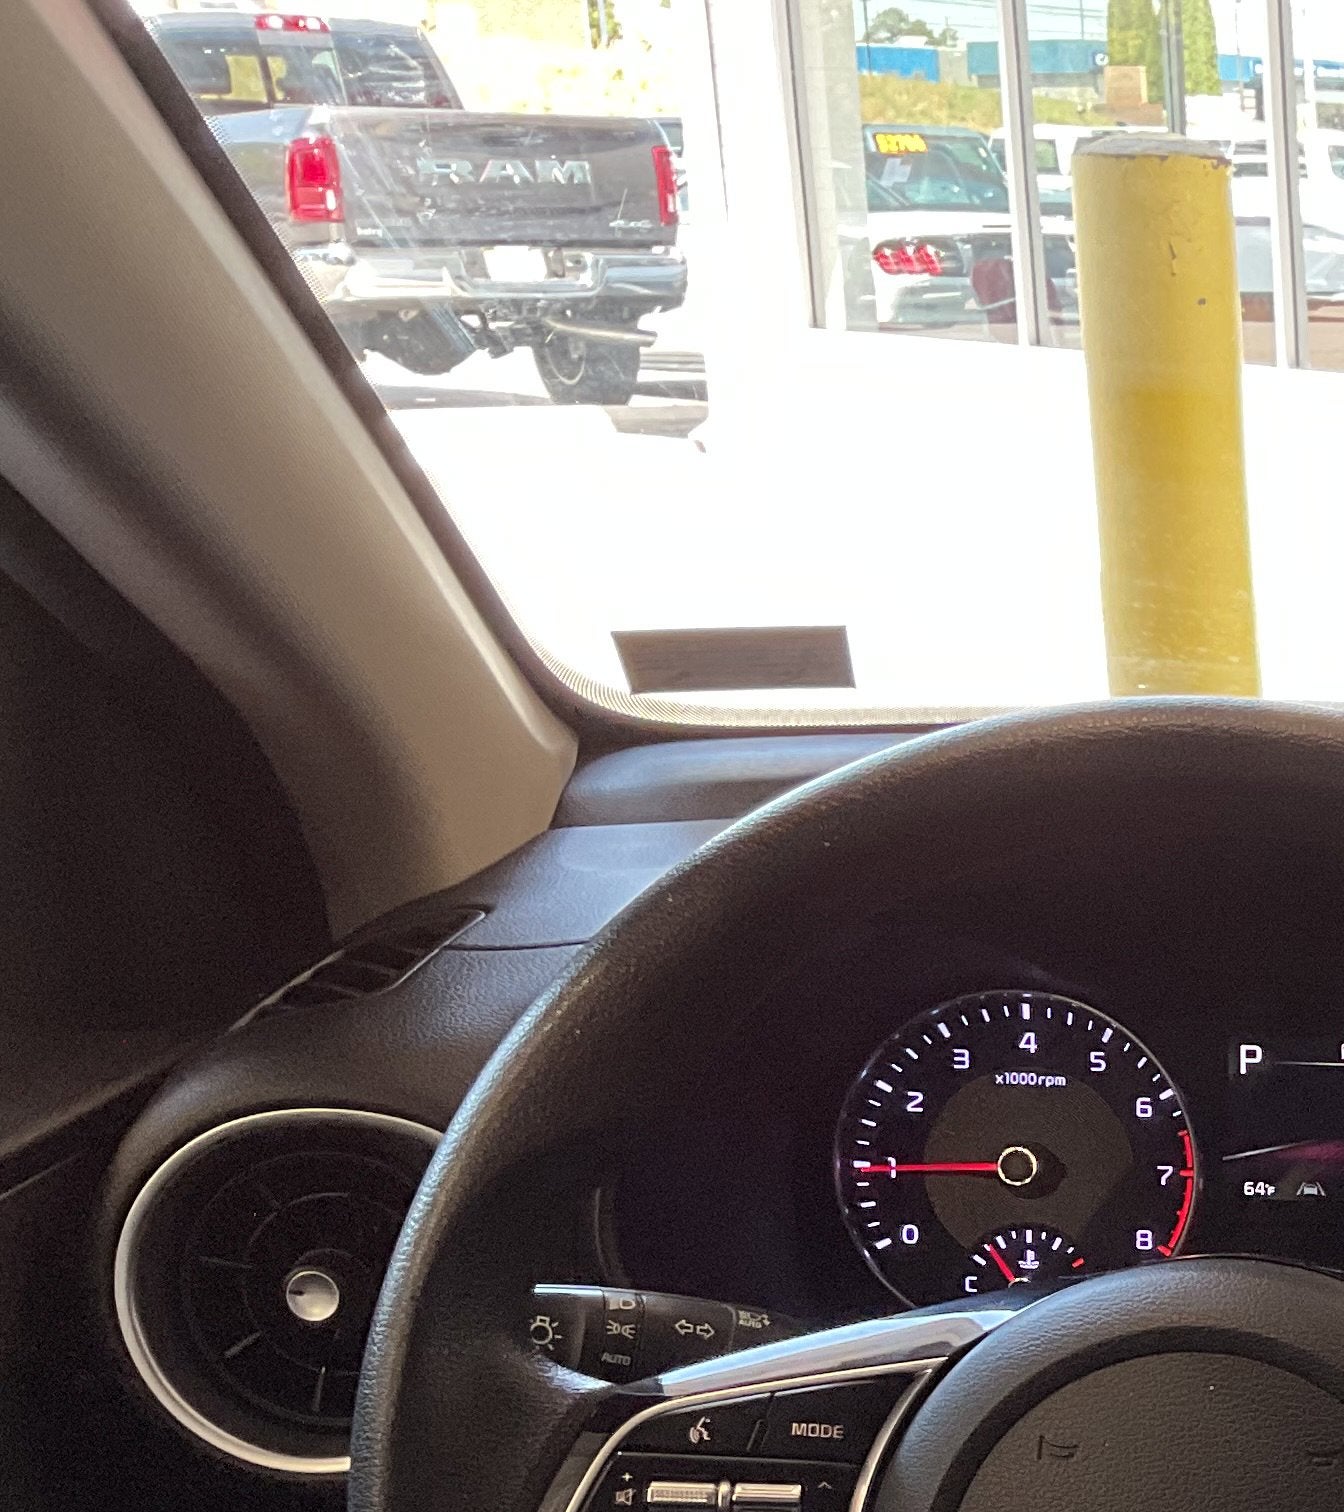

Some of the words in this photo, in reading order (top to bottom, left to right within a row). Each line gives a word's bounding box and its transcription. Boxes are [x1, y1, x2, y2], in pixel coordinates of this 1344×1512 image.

[416, 159, 592, 185] RAM
[1018, 1031, 1038, 1054] 4
[953, 1048, 970, 1070] 3
[1089, 1051, 1106, 1072] 5
[1239, 1044, 1263, 1075] P
[906, 1091, 924, 1112] 2
[1135, 1097, 1153, 1118] 6
[887, 1156, 897, 1178] 1
[1156, 1165, 1174, 1186] 7
[901, 1223, 919, 1245] 0
[1135, 1229, 1153, 1250] 8
[964, 1275, 978, 1293] C
[600, 1351, 632, 1366] AUTO
[790, 1422, 845, 1439] MODE
